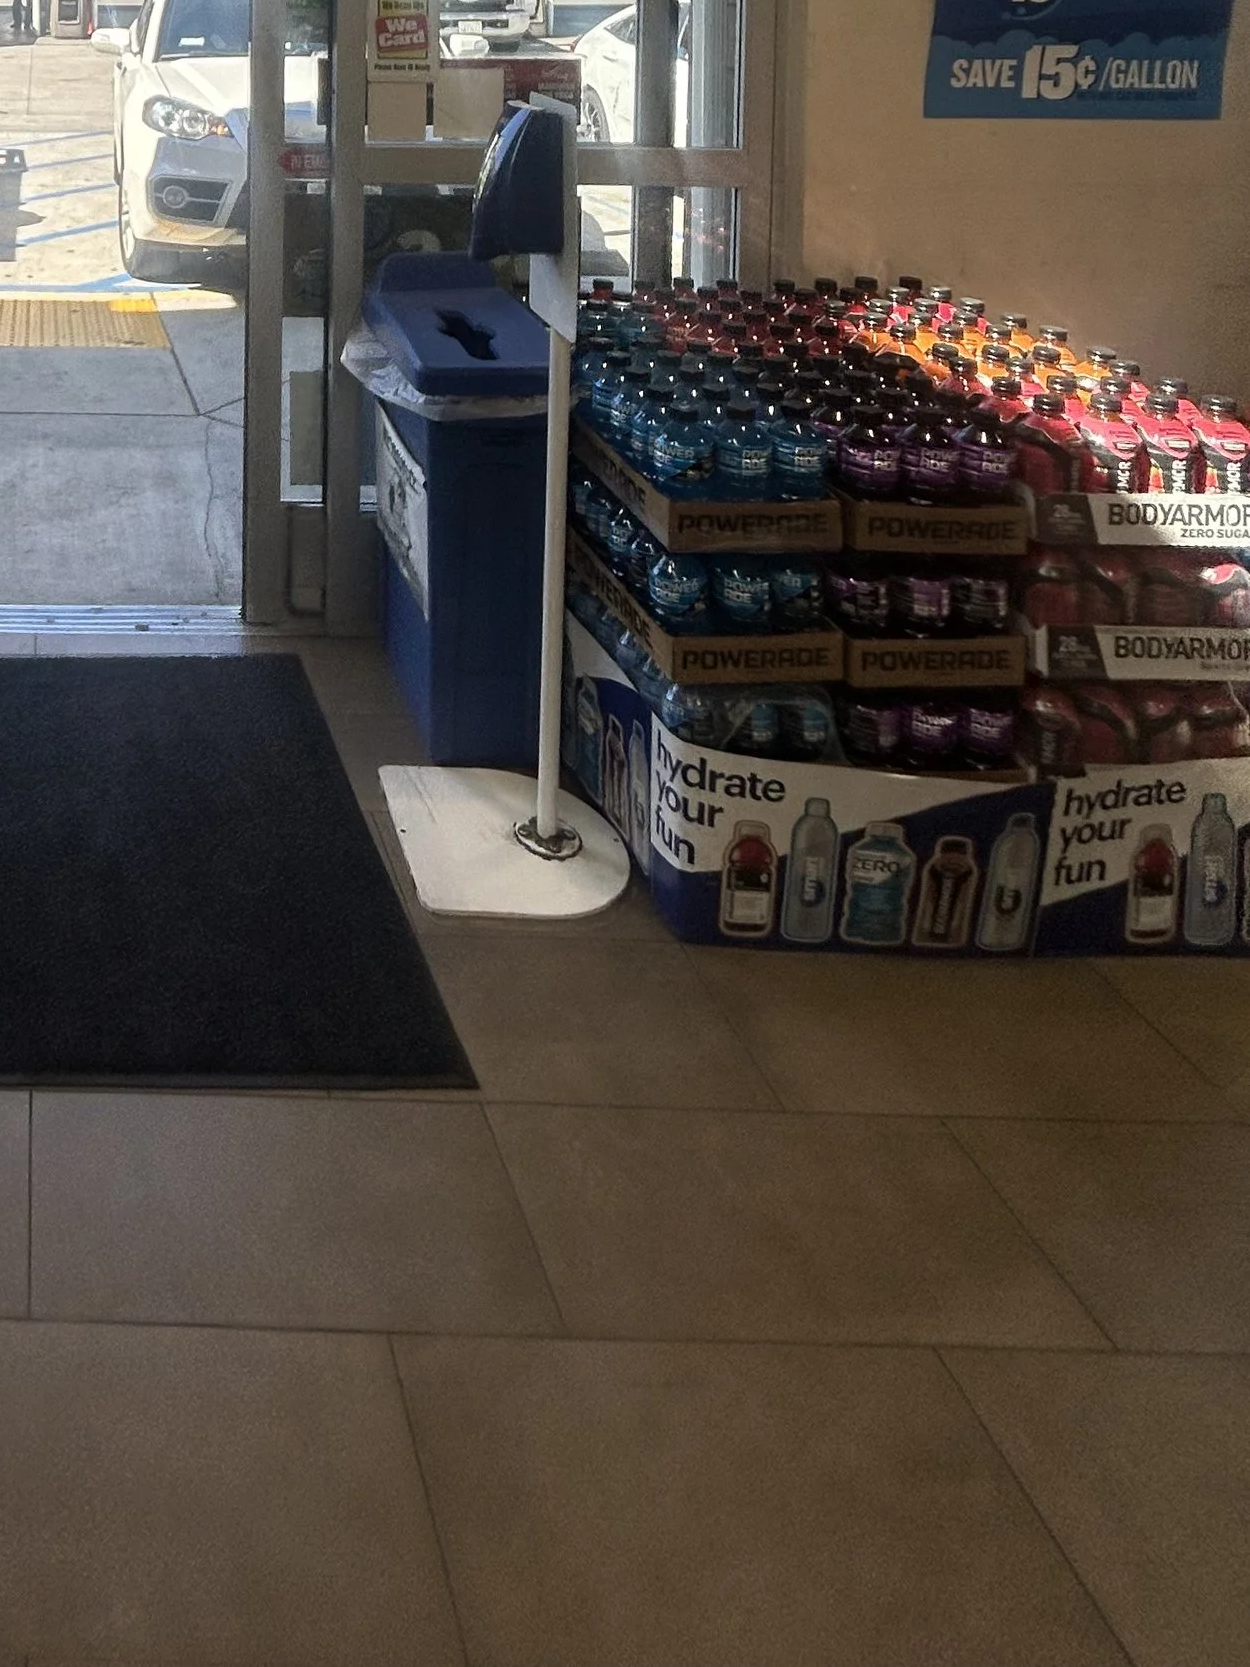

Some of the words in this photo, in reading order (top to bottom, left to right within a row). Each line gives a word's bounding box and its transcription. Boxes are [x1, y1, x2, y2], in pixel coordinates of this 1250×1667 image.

[385, 18, 418, 32] We
[378, 29, 426, 47] Card
[950, 58, 1019, 88] SAVE
[1020, 44, 1097, 101] 15¢
[1099, 58, 1199, 92] /GALLON
[677, 512, 829, 534] POWERADE
[868, 515, 1019, 540] POWERADE
[1181, 528, 1214, 538] ZERO
[1216, 528, 1250, 539] SUGA
[681, 647, 831, 670] POWERADE
[860, 649, 1011, 672] POWERADE
[657, 730, 785, 802] hydrate
[657, 770, 724, 828] your
[1064, 779, 1186, 817] hydrate
[656, 805, 695, 865] fun
[1060, 816, 1132, 856] your
[853, 857, 900, 875] ZERO
[1055, 855, 1106, 888] fun
